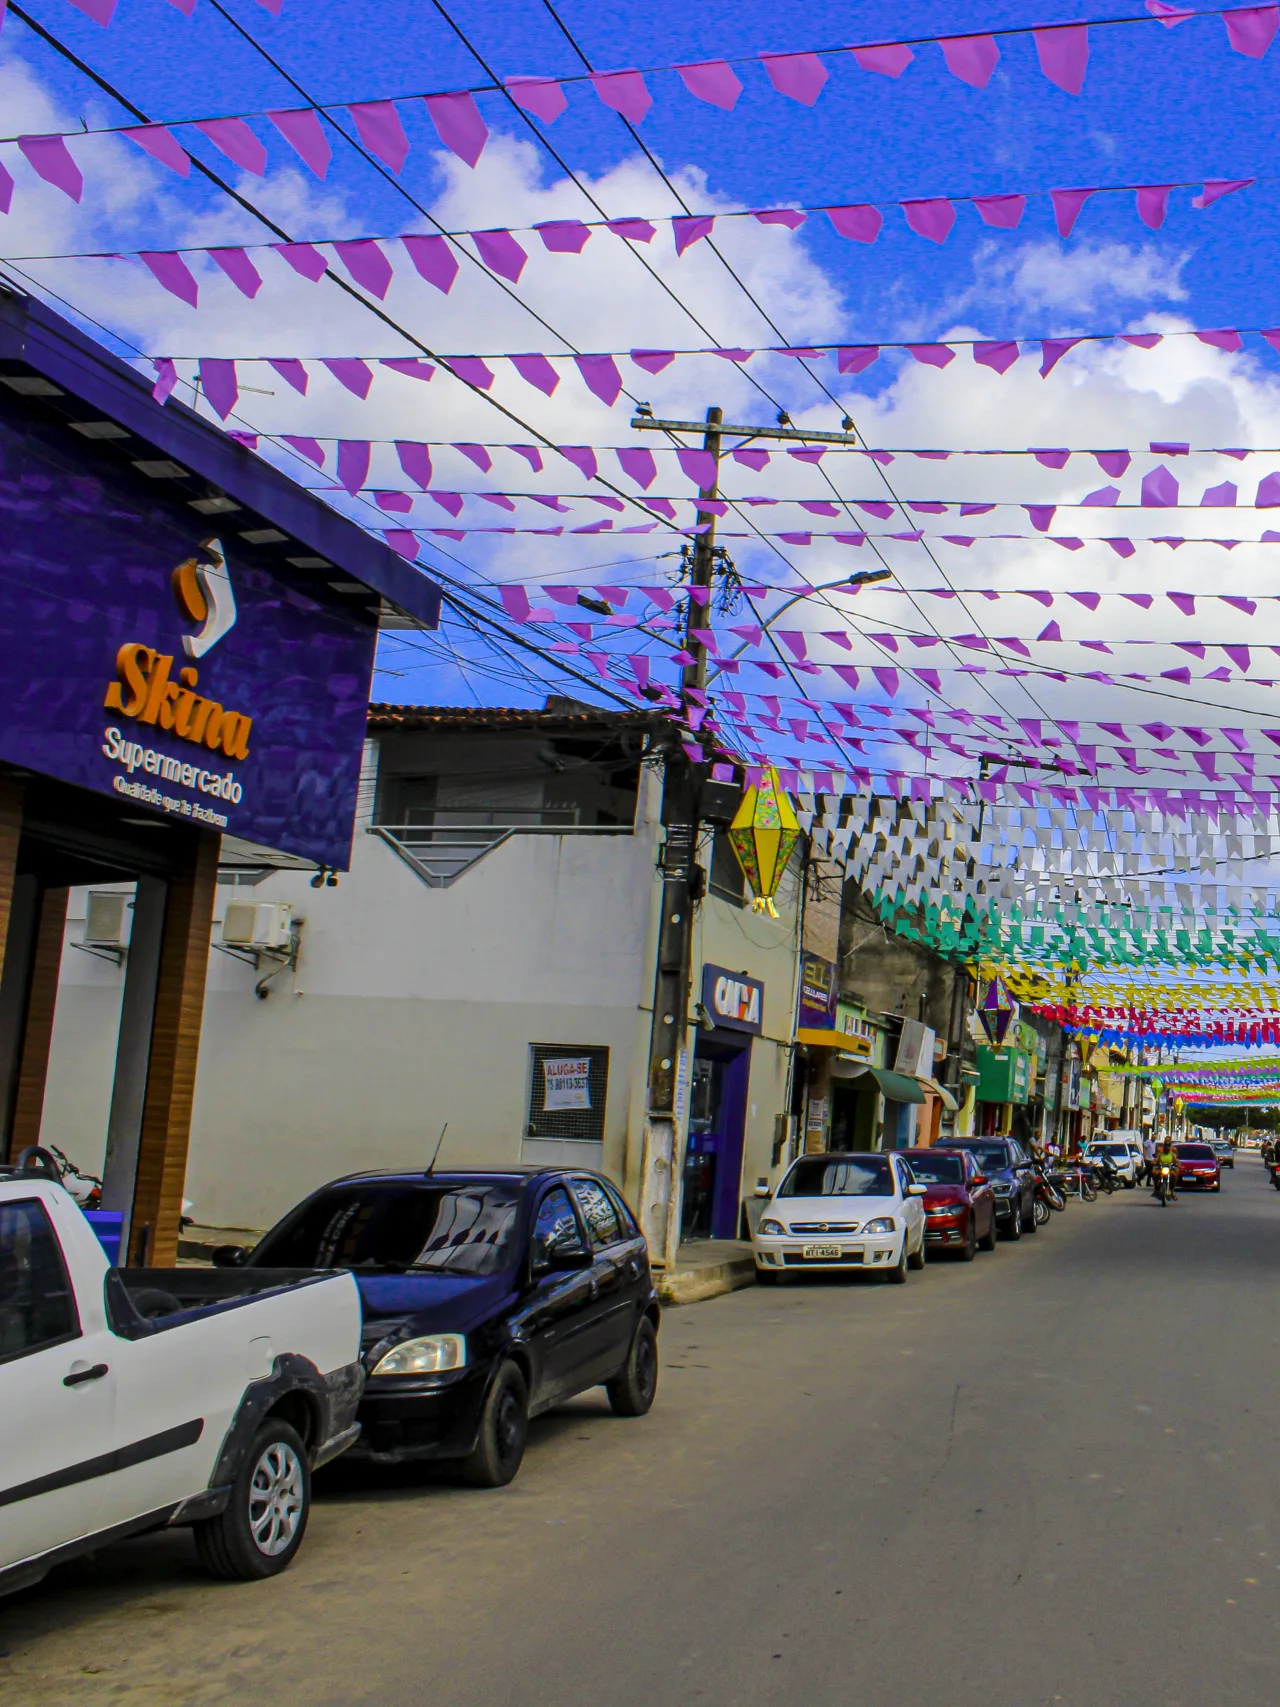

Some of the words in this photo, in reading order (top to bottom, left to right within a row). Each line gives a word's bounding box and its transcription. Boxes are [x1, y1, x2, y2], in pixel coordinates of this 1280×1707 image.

[104, 643, 252, 760] Skina
[103, 727, 242, 803] Supermercado
[547, 1062, 588, 1076] ALUGA-SE
